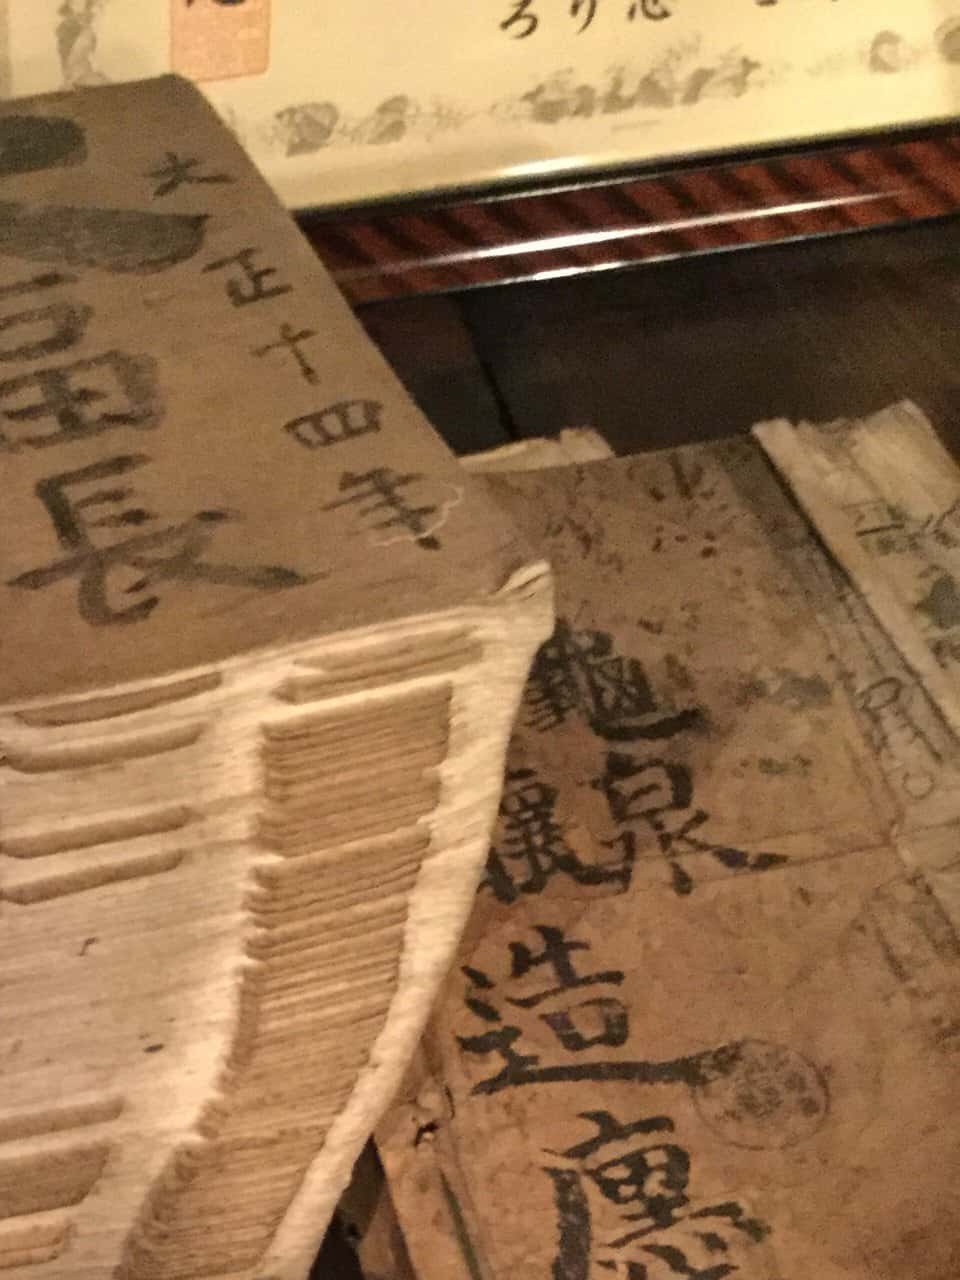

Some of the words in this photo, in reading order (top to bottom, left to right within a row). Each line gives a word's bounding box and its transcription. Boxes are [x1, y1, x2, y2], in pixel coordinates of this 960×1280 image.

[144, 150, 440, 550] 大正十四年
